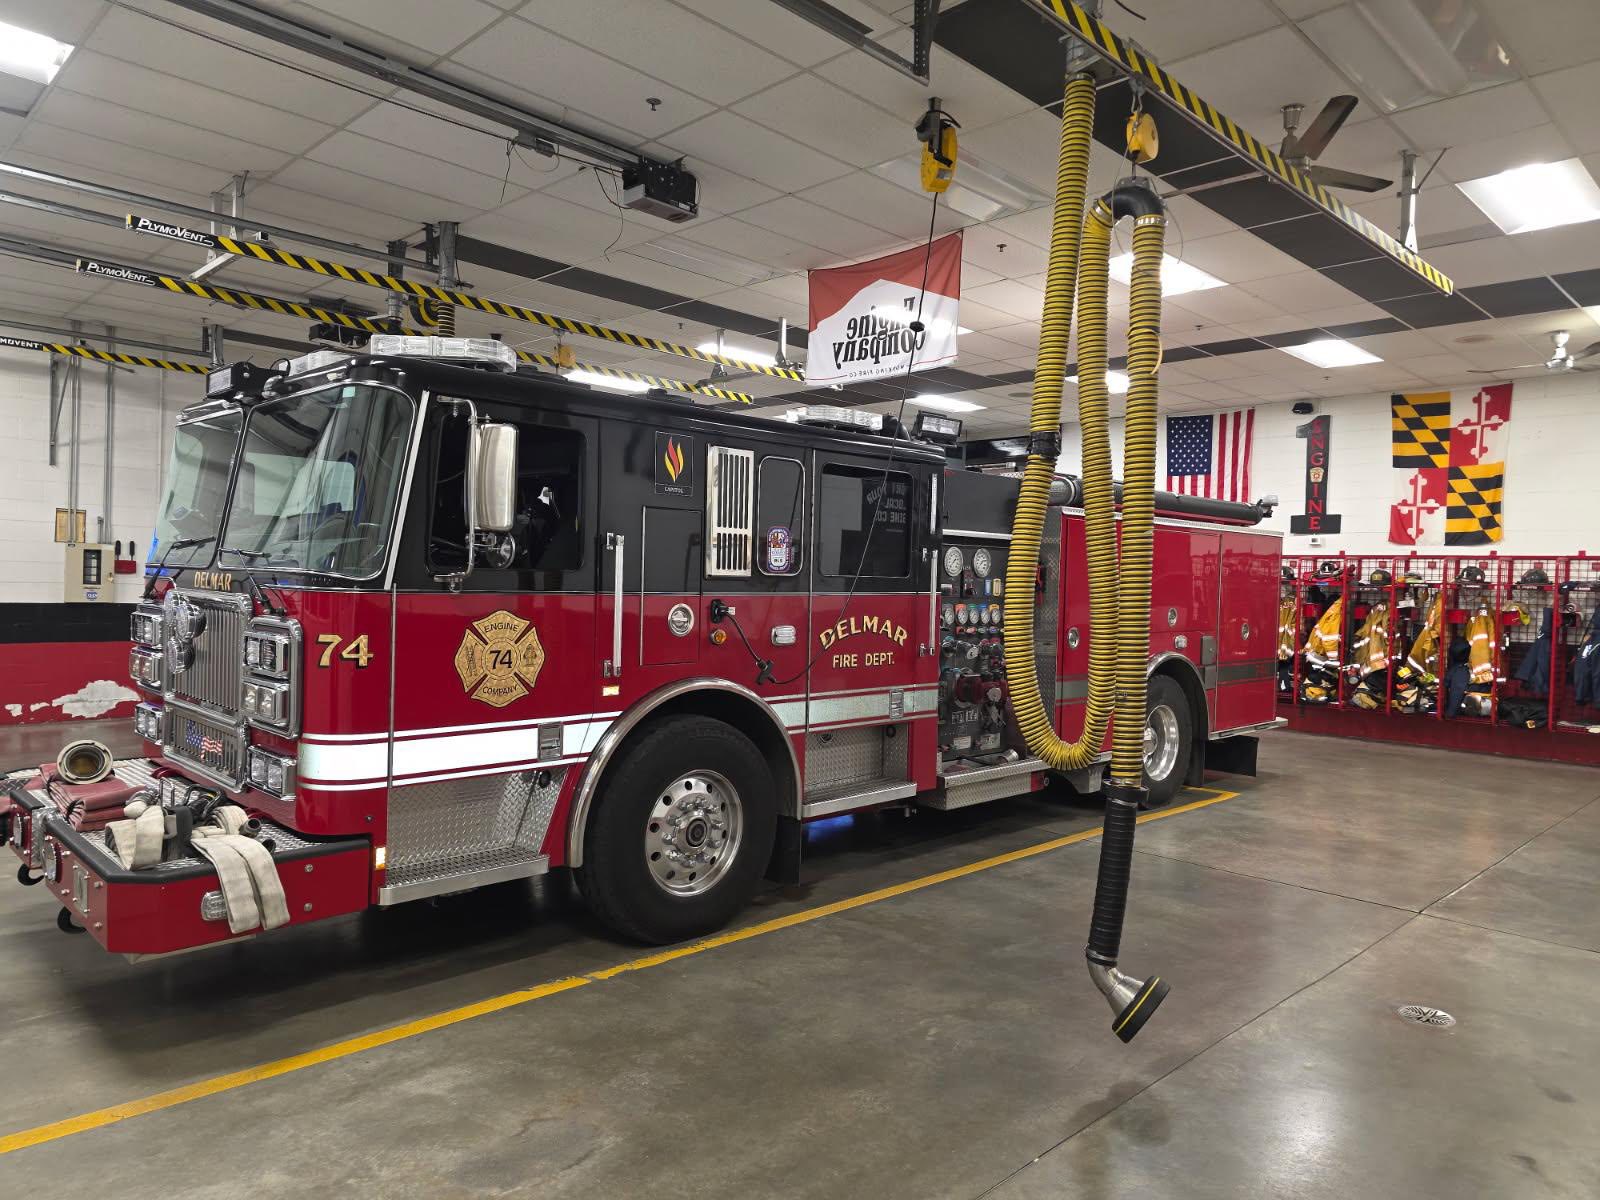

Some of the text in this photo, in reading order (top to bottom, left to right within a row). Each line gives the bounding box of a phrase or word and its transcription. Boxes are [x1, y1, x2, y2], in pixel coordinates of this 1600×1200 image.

[194, 571, 232, 591] DELMAR
[484, 622, 519, 632] ENGINE
[819, 615, 908, 650] DELMAR
[317, 634, 374, 668] 74
[489, 649, 512, 669] 74
[832, 652, 895, 668] FIRE DEPT.
[482, 685, 518, 696] COMPANY
